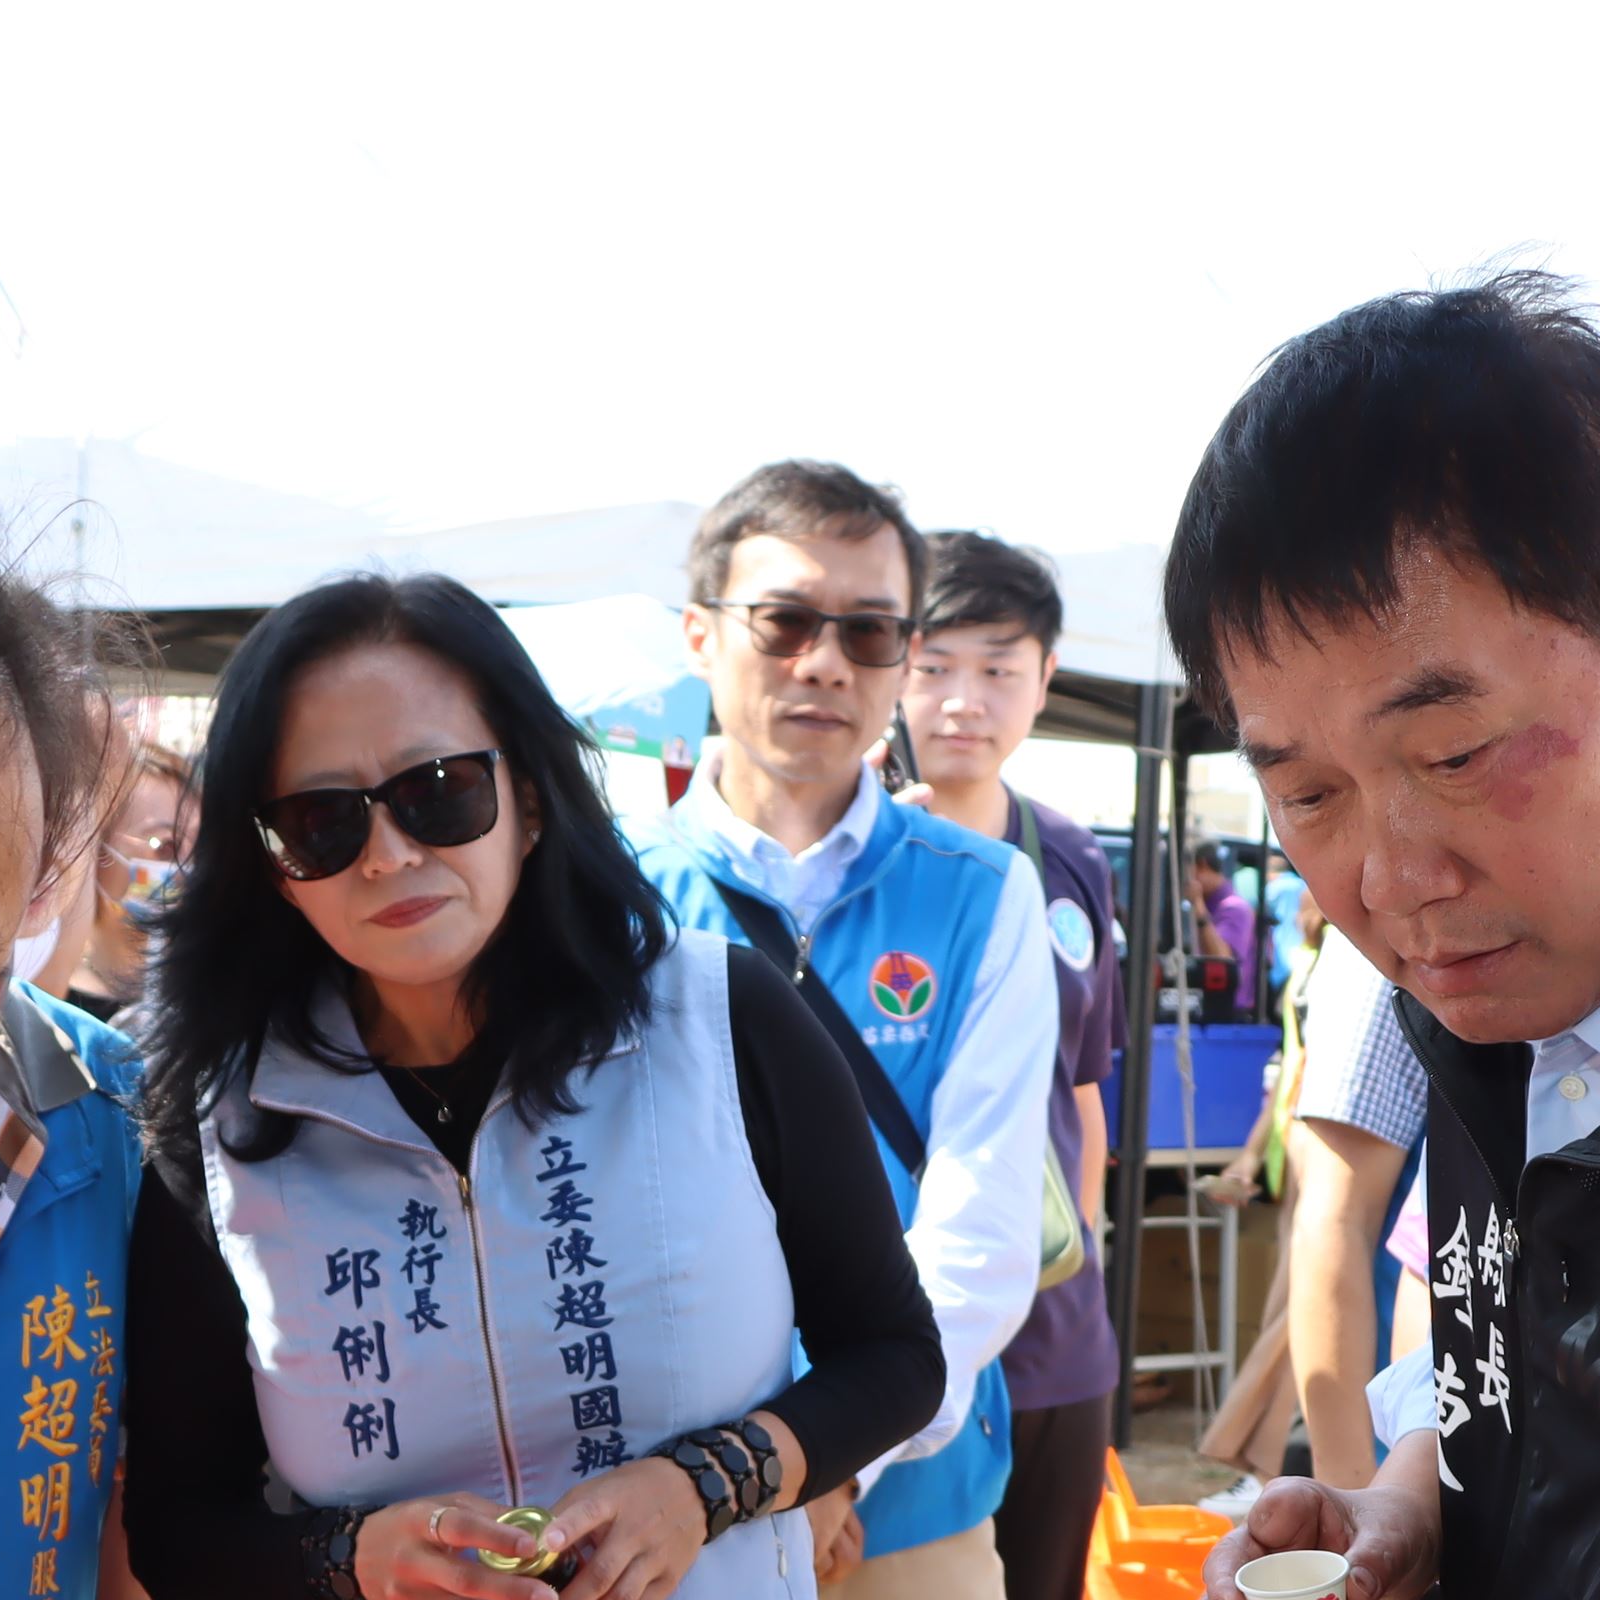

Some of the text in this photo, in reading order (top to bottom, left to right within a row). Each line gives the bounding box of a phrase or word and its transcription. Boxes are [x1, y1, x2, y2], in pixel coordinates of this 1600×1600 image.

[399, 1199, 448, 1333] 執行長
[324, 1246, 401, 1461] 邱俐俐
